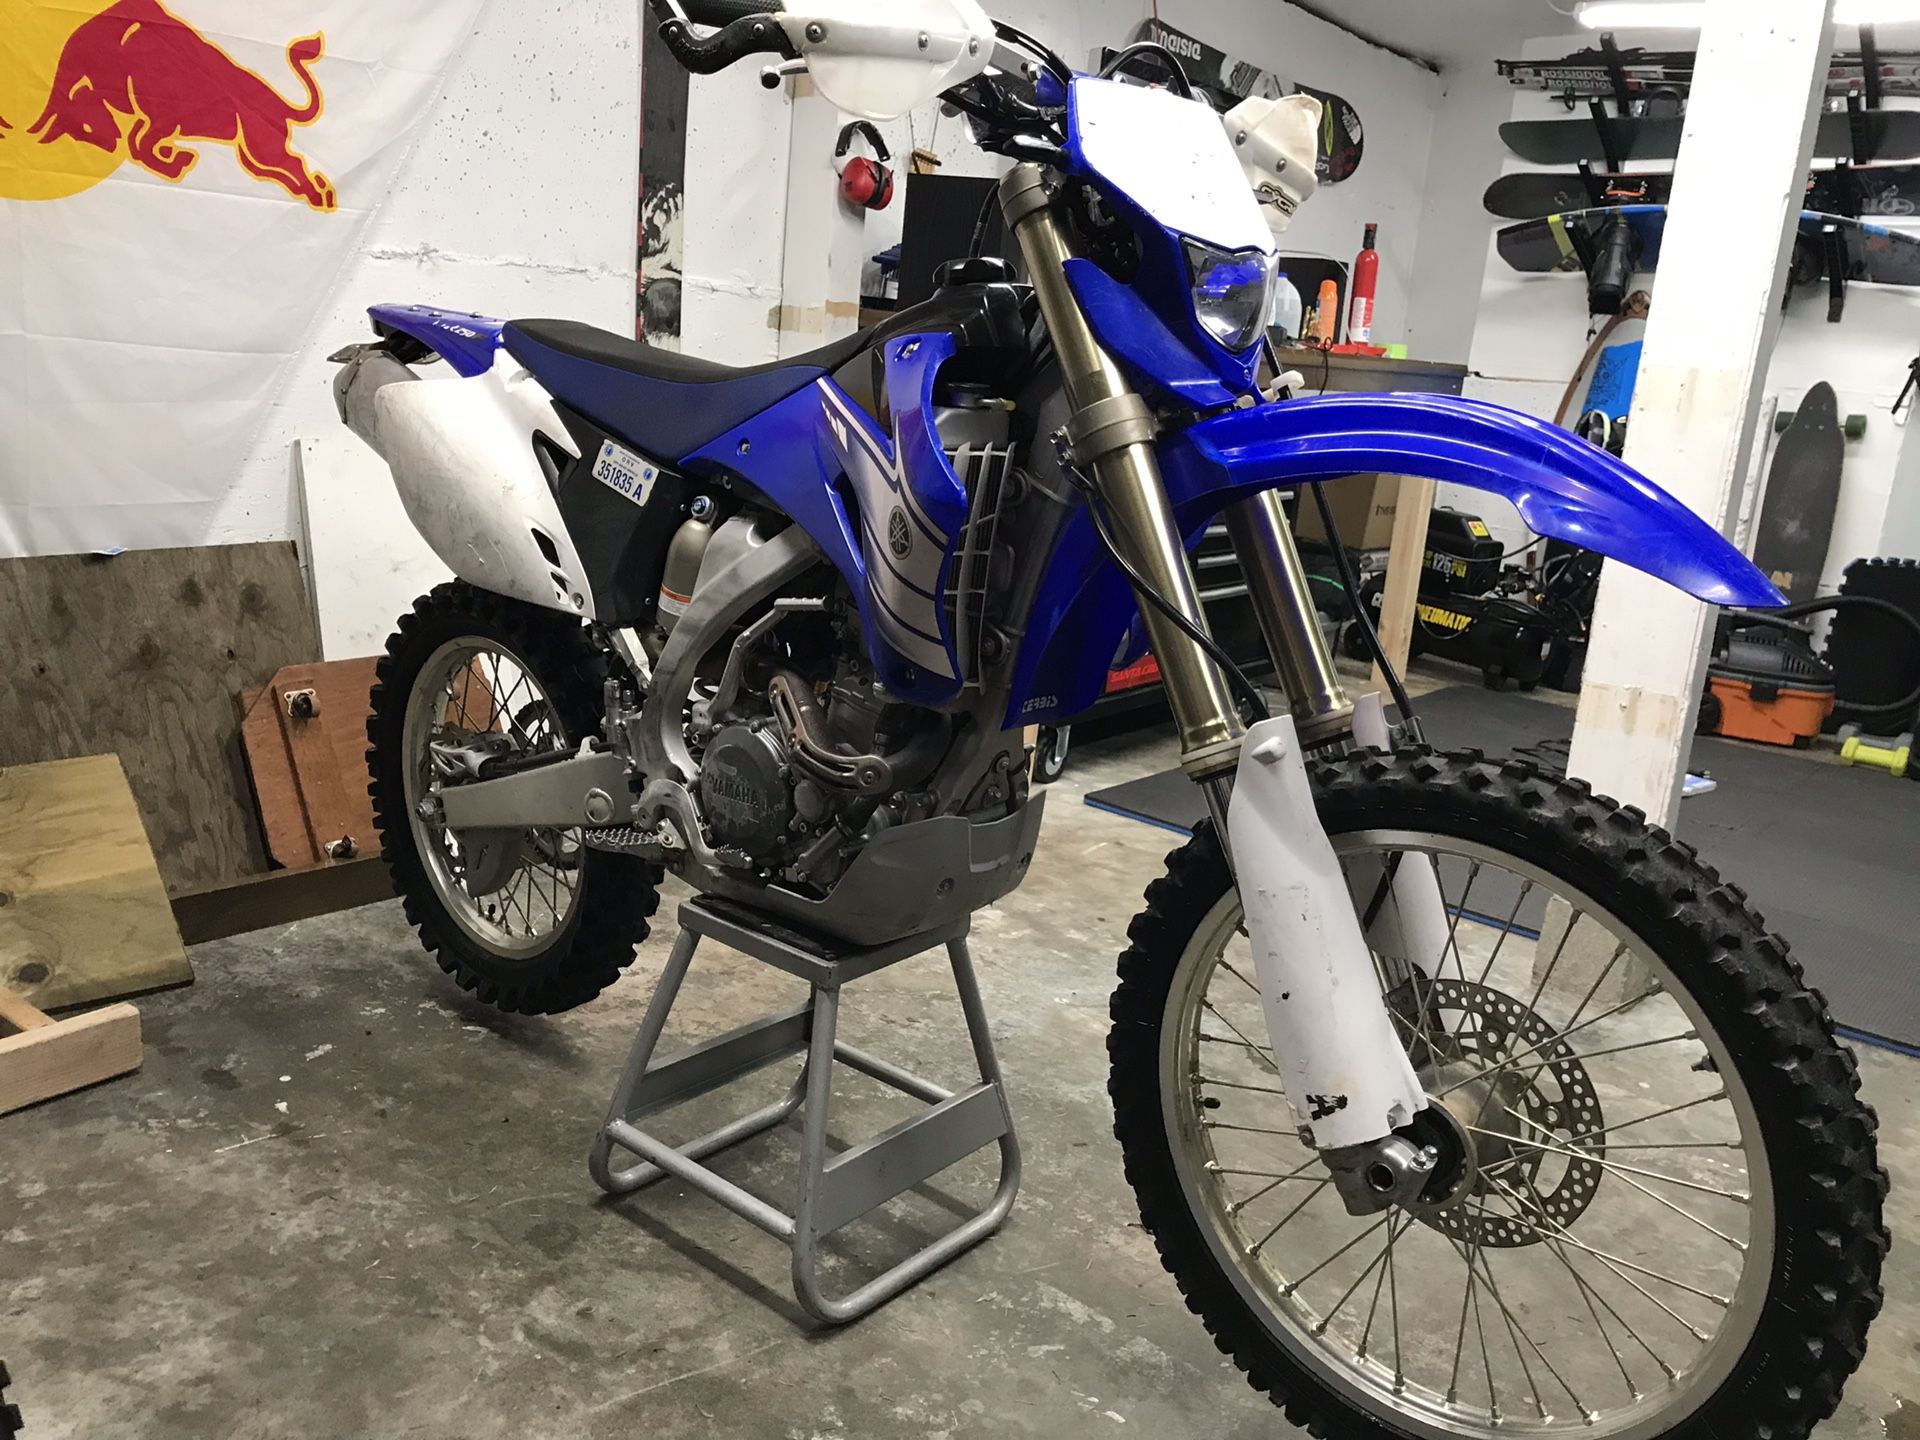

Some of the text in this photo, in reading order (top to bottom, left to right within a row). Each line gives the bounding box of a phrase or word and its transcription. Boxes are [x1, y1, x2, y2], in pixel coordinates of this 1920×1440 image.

[597, 460, 634, 493] 351835
[632, 483, 644, 501] A
[1432, 552, 1452, 574] 125
